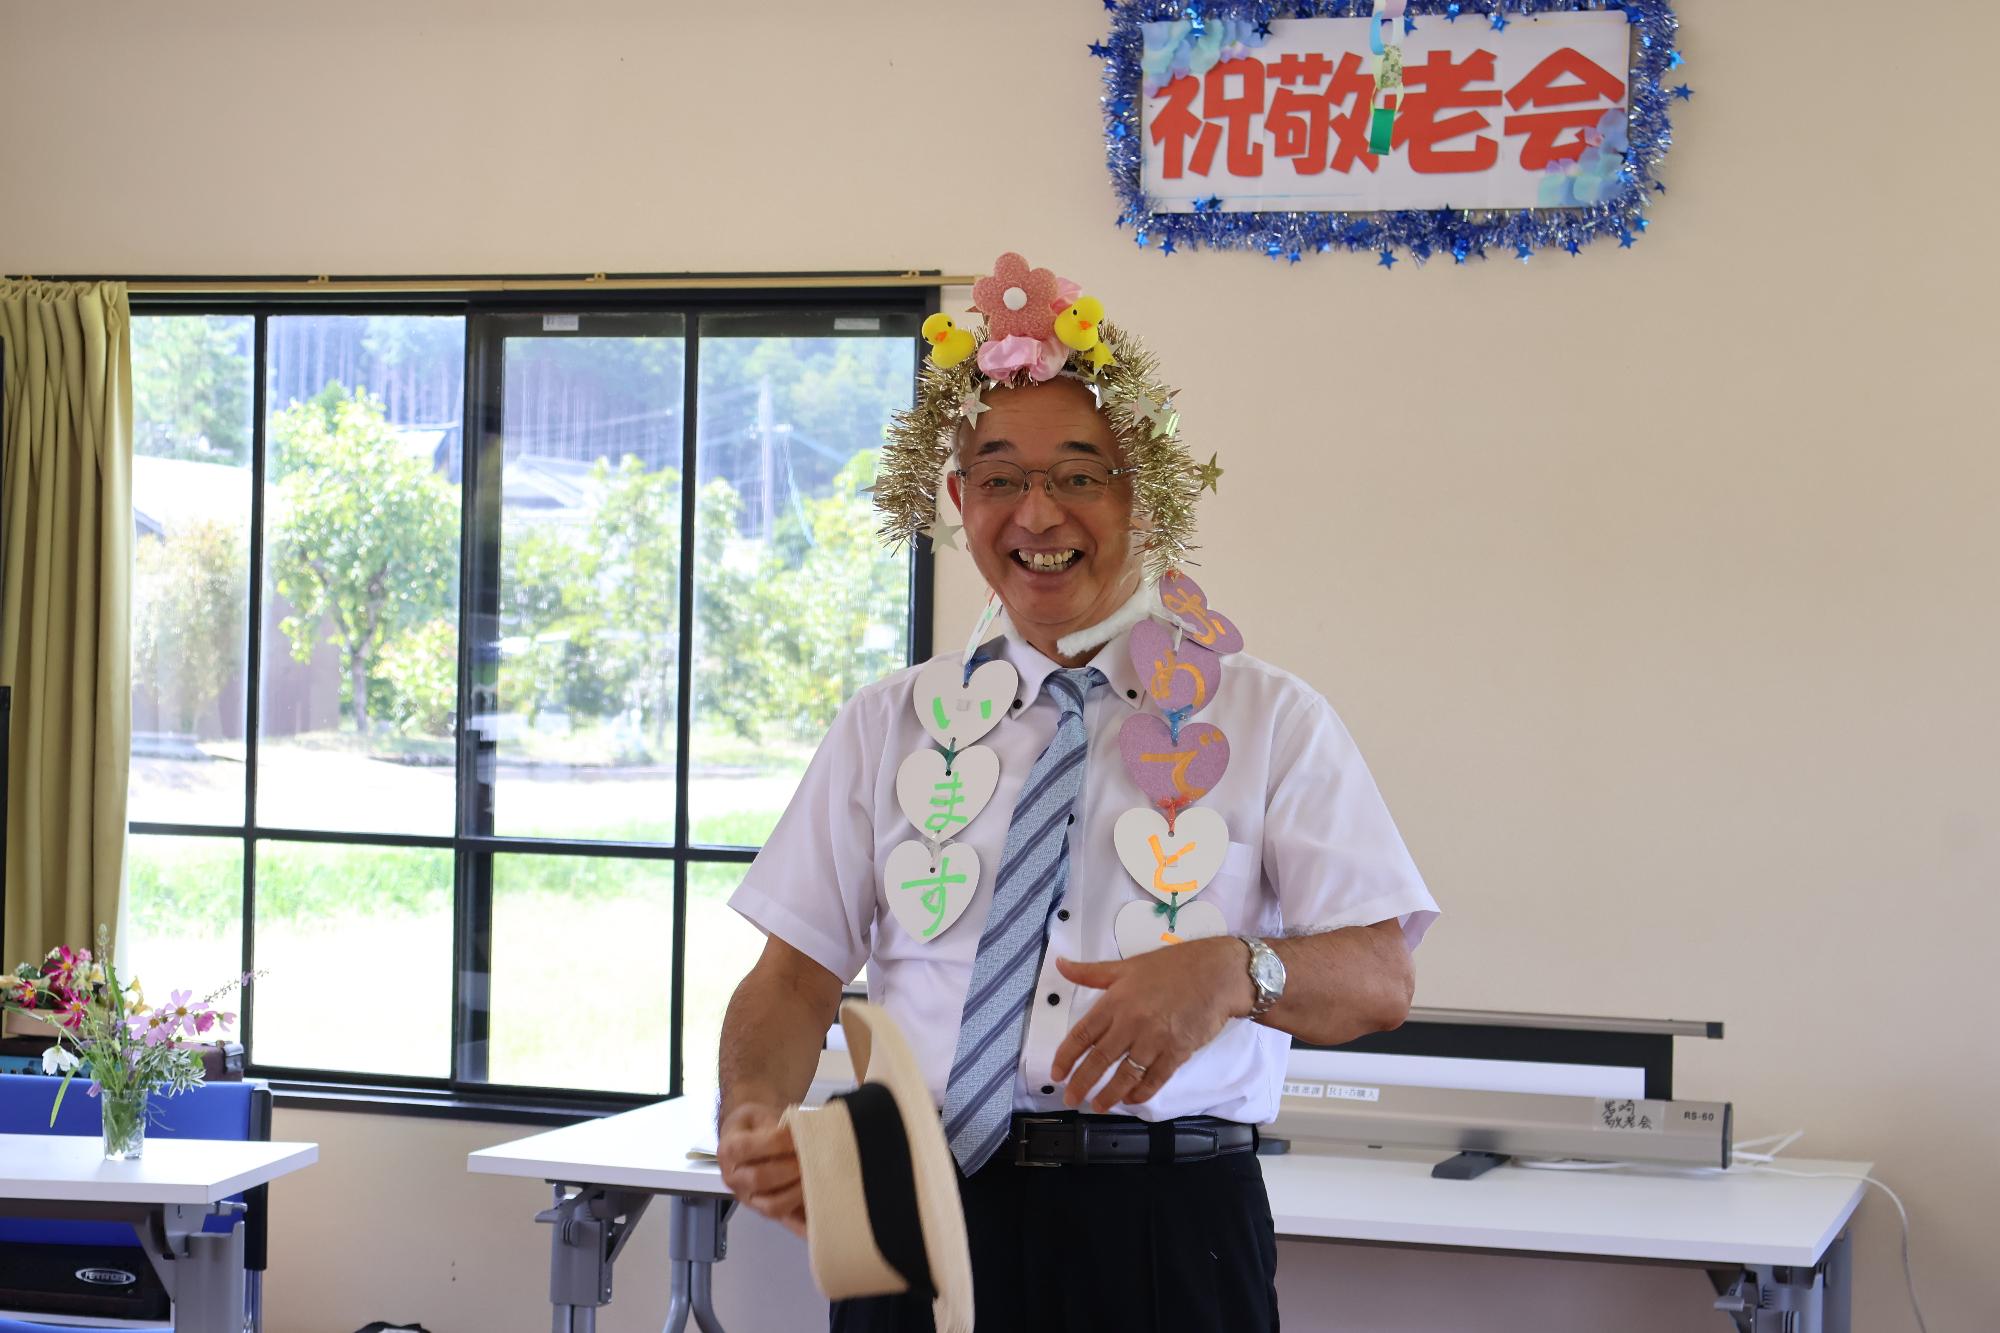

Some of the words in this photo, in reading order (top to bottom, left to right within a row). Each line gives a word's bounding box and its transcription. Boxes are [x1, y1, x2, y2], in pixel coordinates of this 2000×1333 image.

[1150, 47, 1625, 179] 祝敬老会
[1684, 1111, 1714, 1121] RS-60
